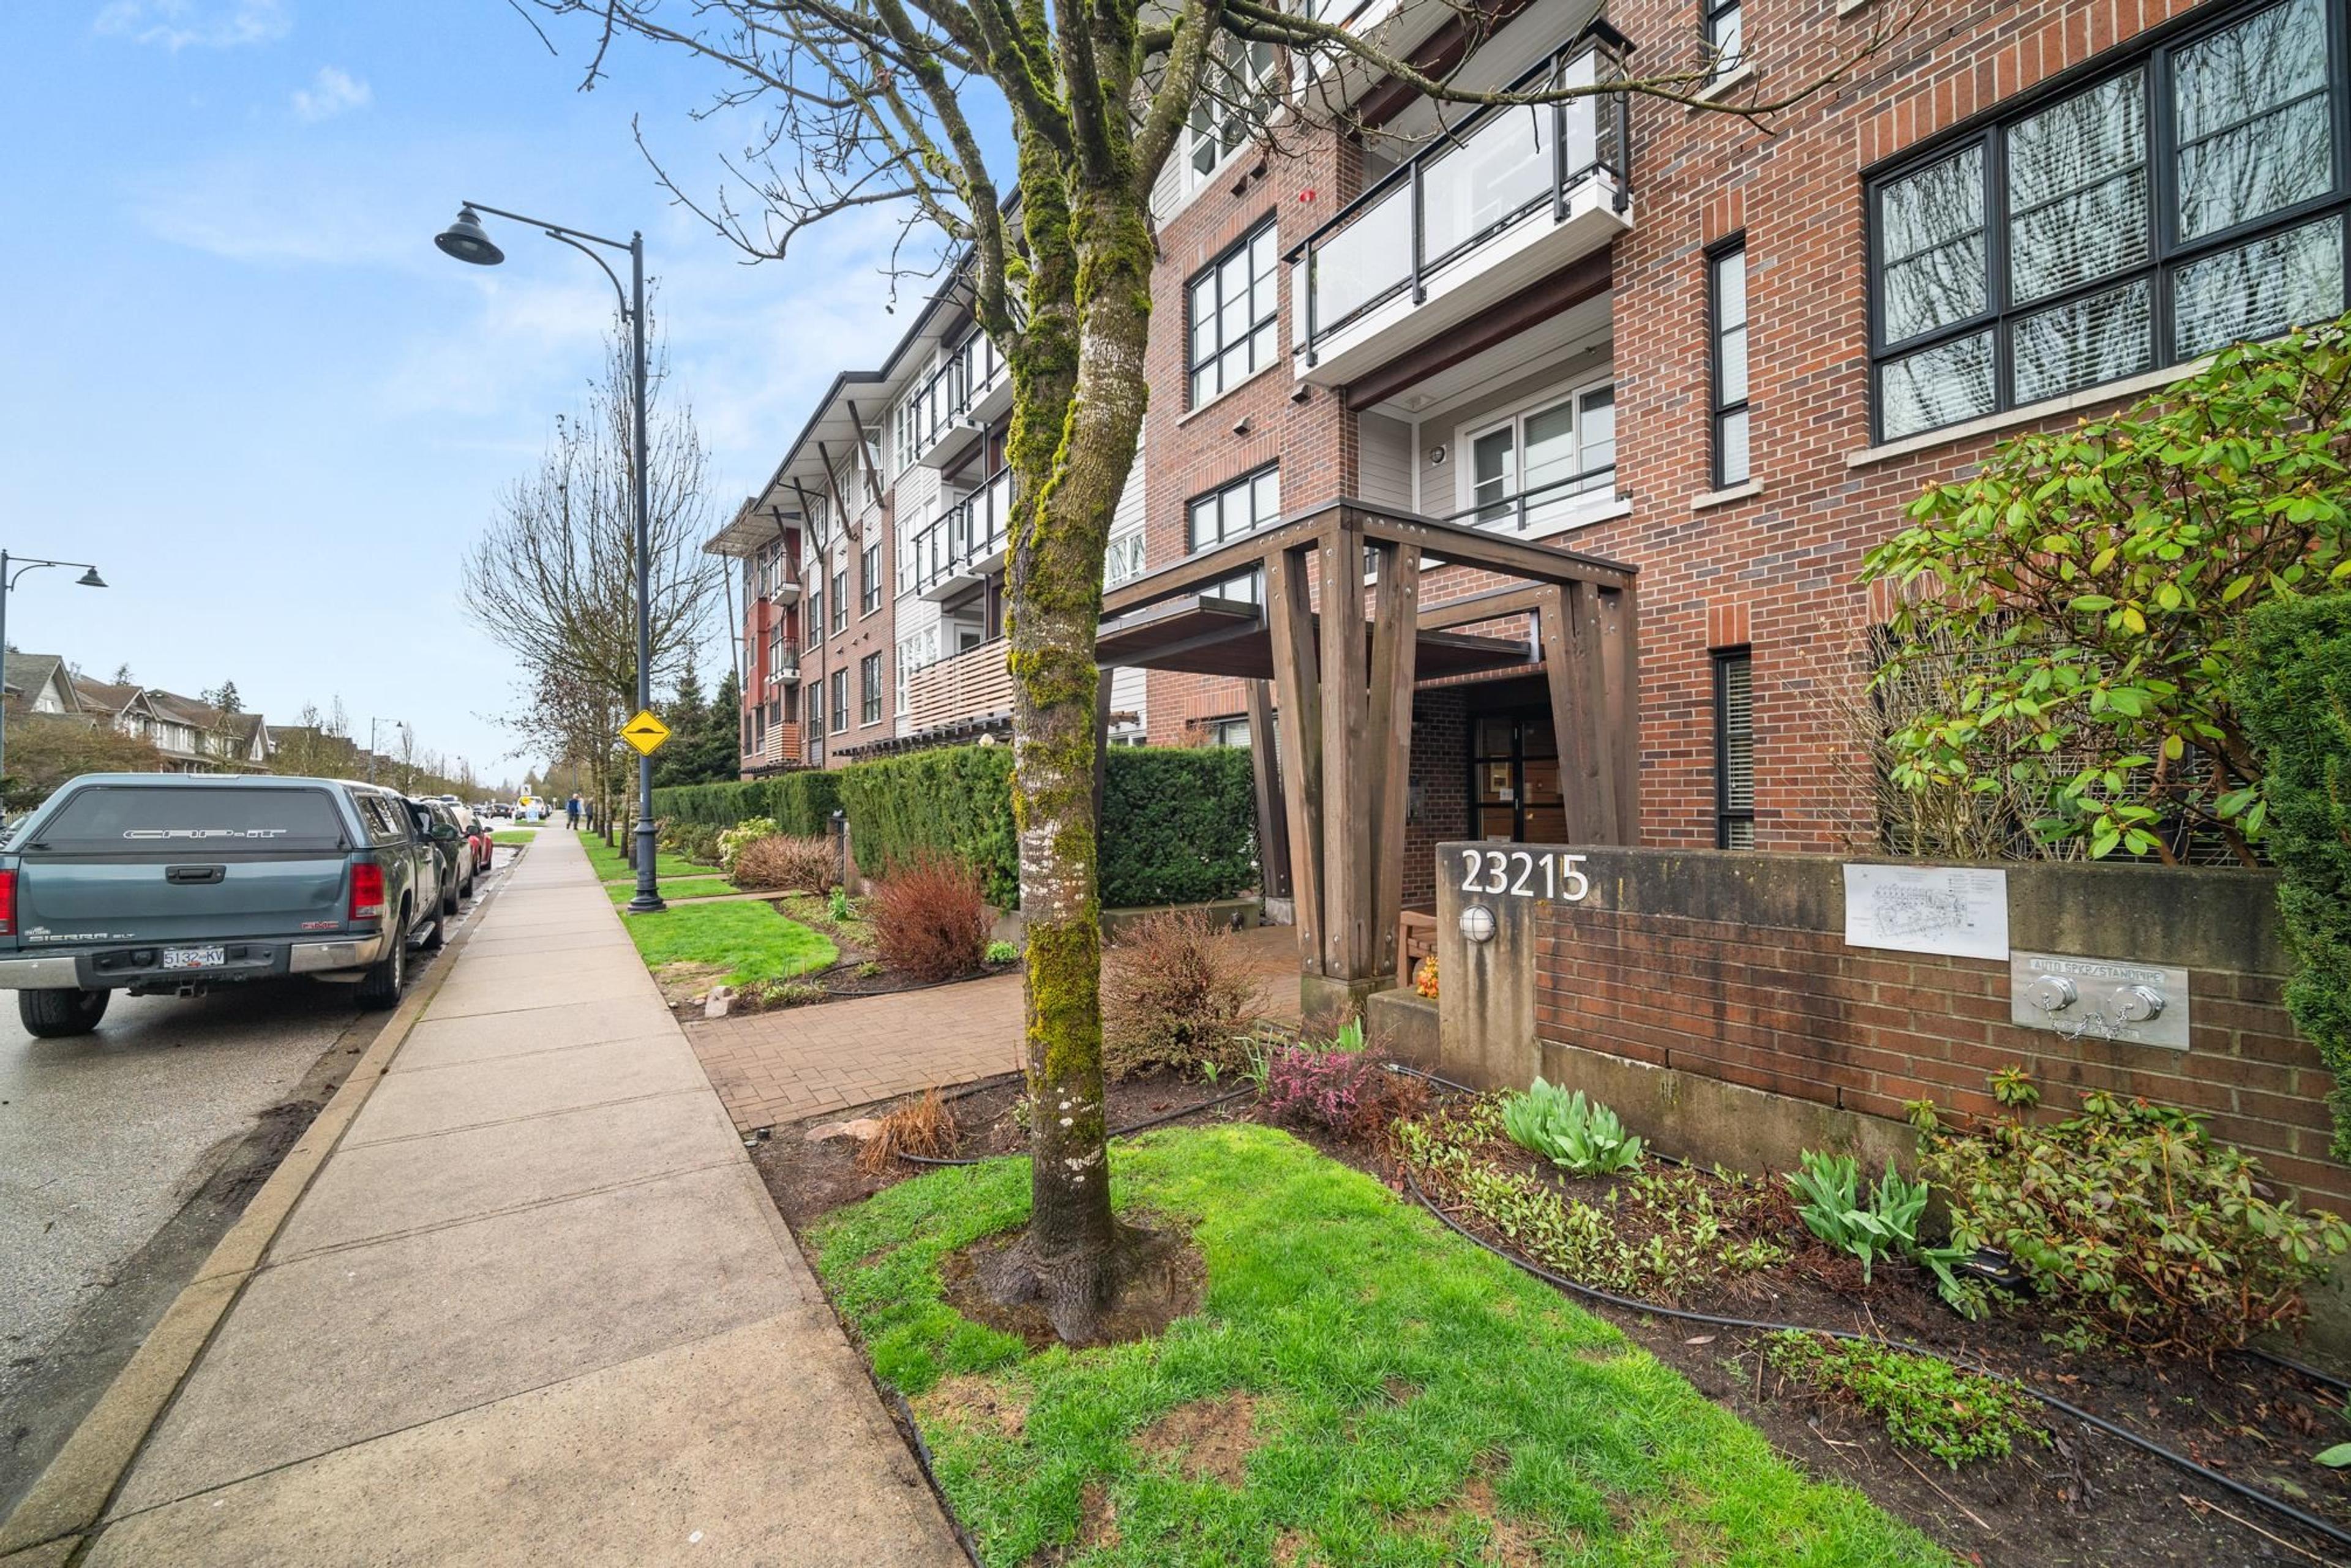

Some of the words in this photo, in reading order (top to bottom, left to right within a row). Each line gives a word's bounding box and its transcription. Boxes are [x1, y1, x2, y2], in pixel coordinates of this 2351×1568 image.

[1461, 849, 1589, 901] 23215
[300, 921, 339, 930] GMC
[29, 932, 108, 942] SIERRA
[2034, 959, 2062, 972] AUTO
